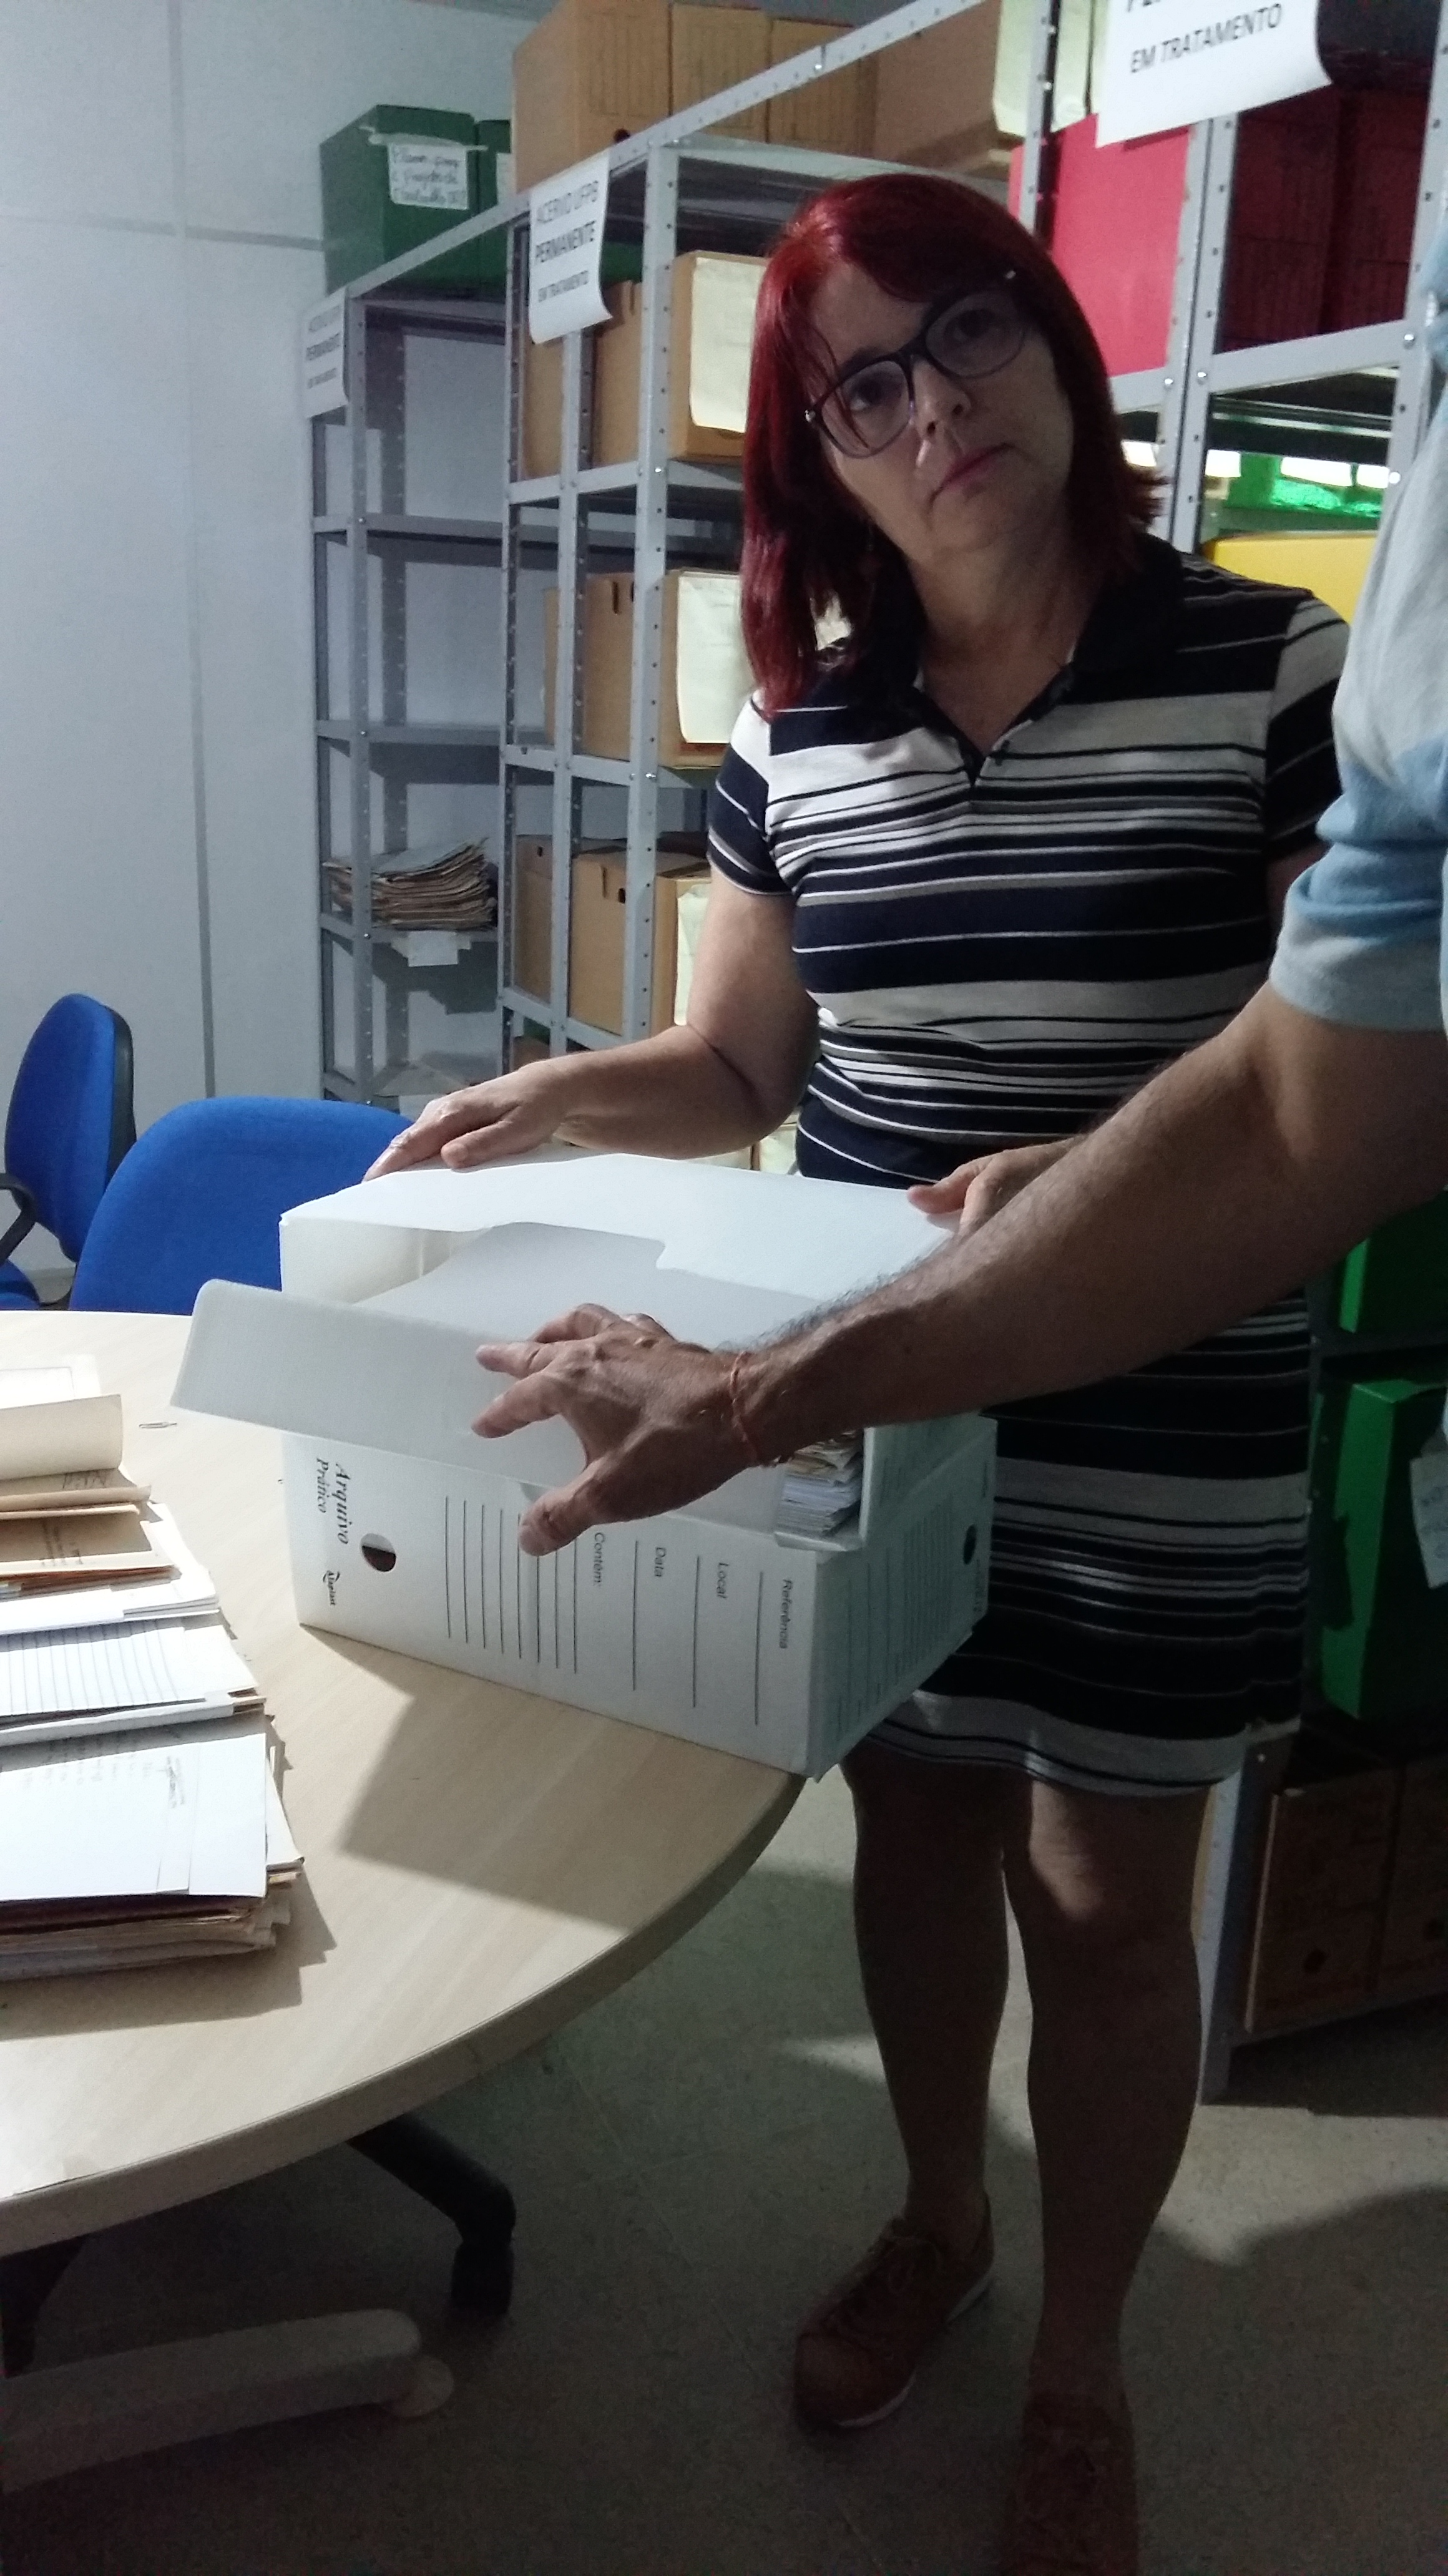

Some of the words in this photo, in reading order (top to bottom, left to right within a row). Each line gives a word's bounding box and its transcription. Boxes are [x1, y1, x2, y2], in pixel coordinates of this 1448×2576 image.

[1131, 46, 1155, 73] EM
[1161, 3, 1282, 62] TRATAMENTO
[535, 220, 596, 263] PERMANENTE
[331, 1462, 352, 1544] Arquivo
[654, 1546, 667, 1578] Data
[716, 1561, 730, 1599] Local
[778, 1578, 794, 1649] Referência
